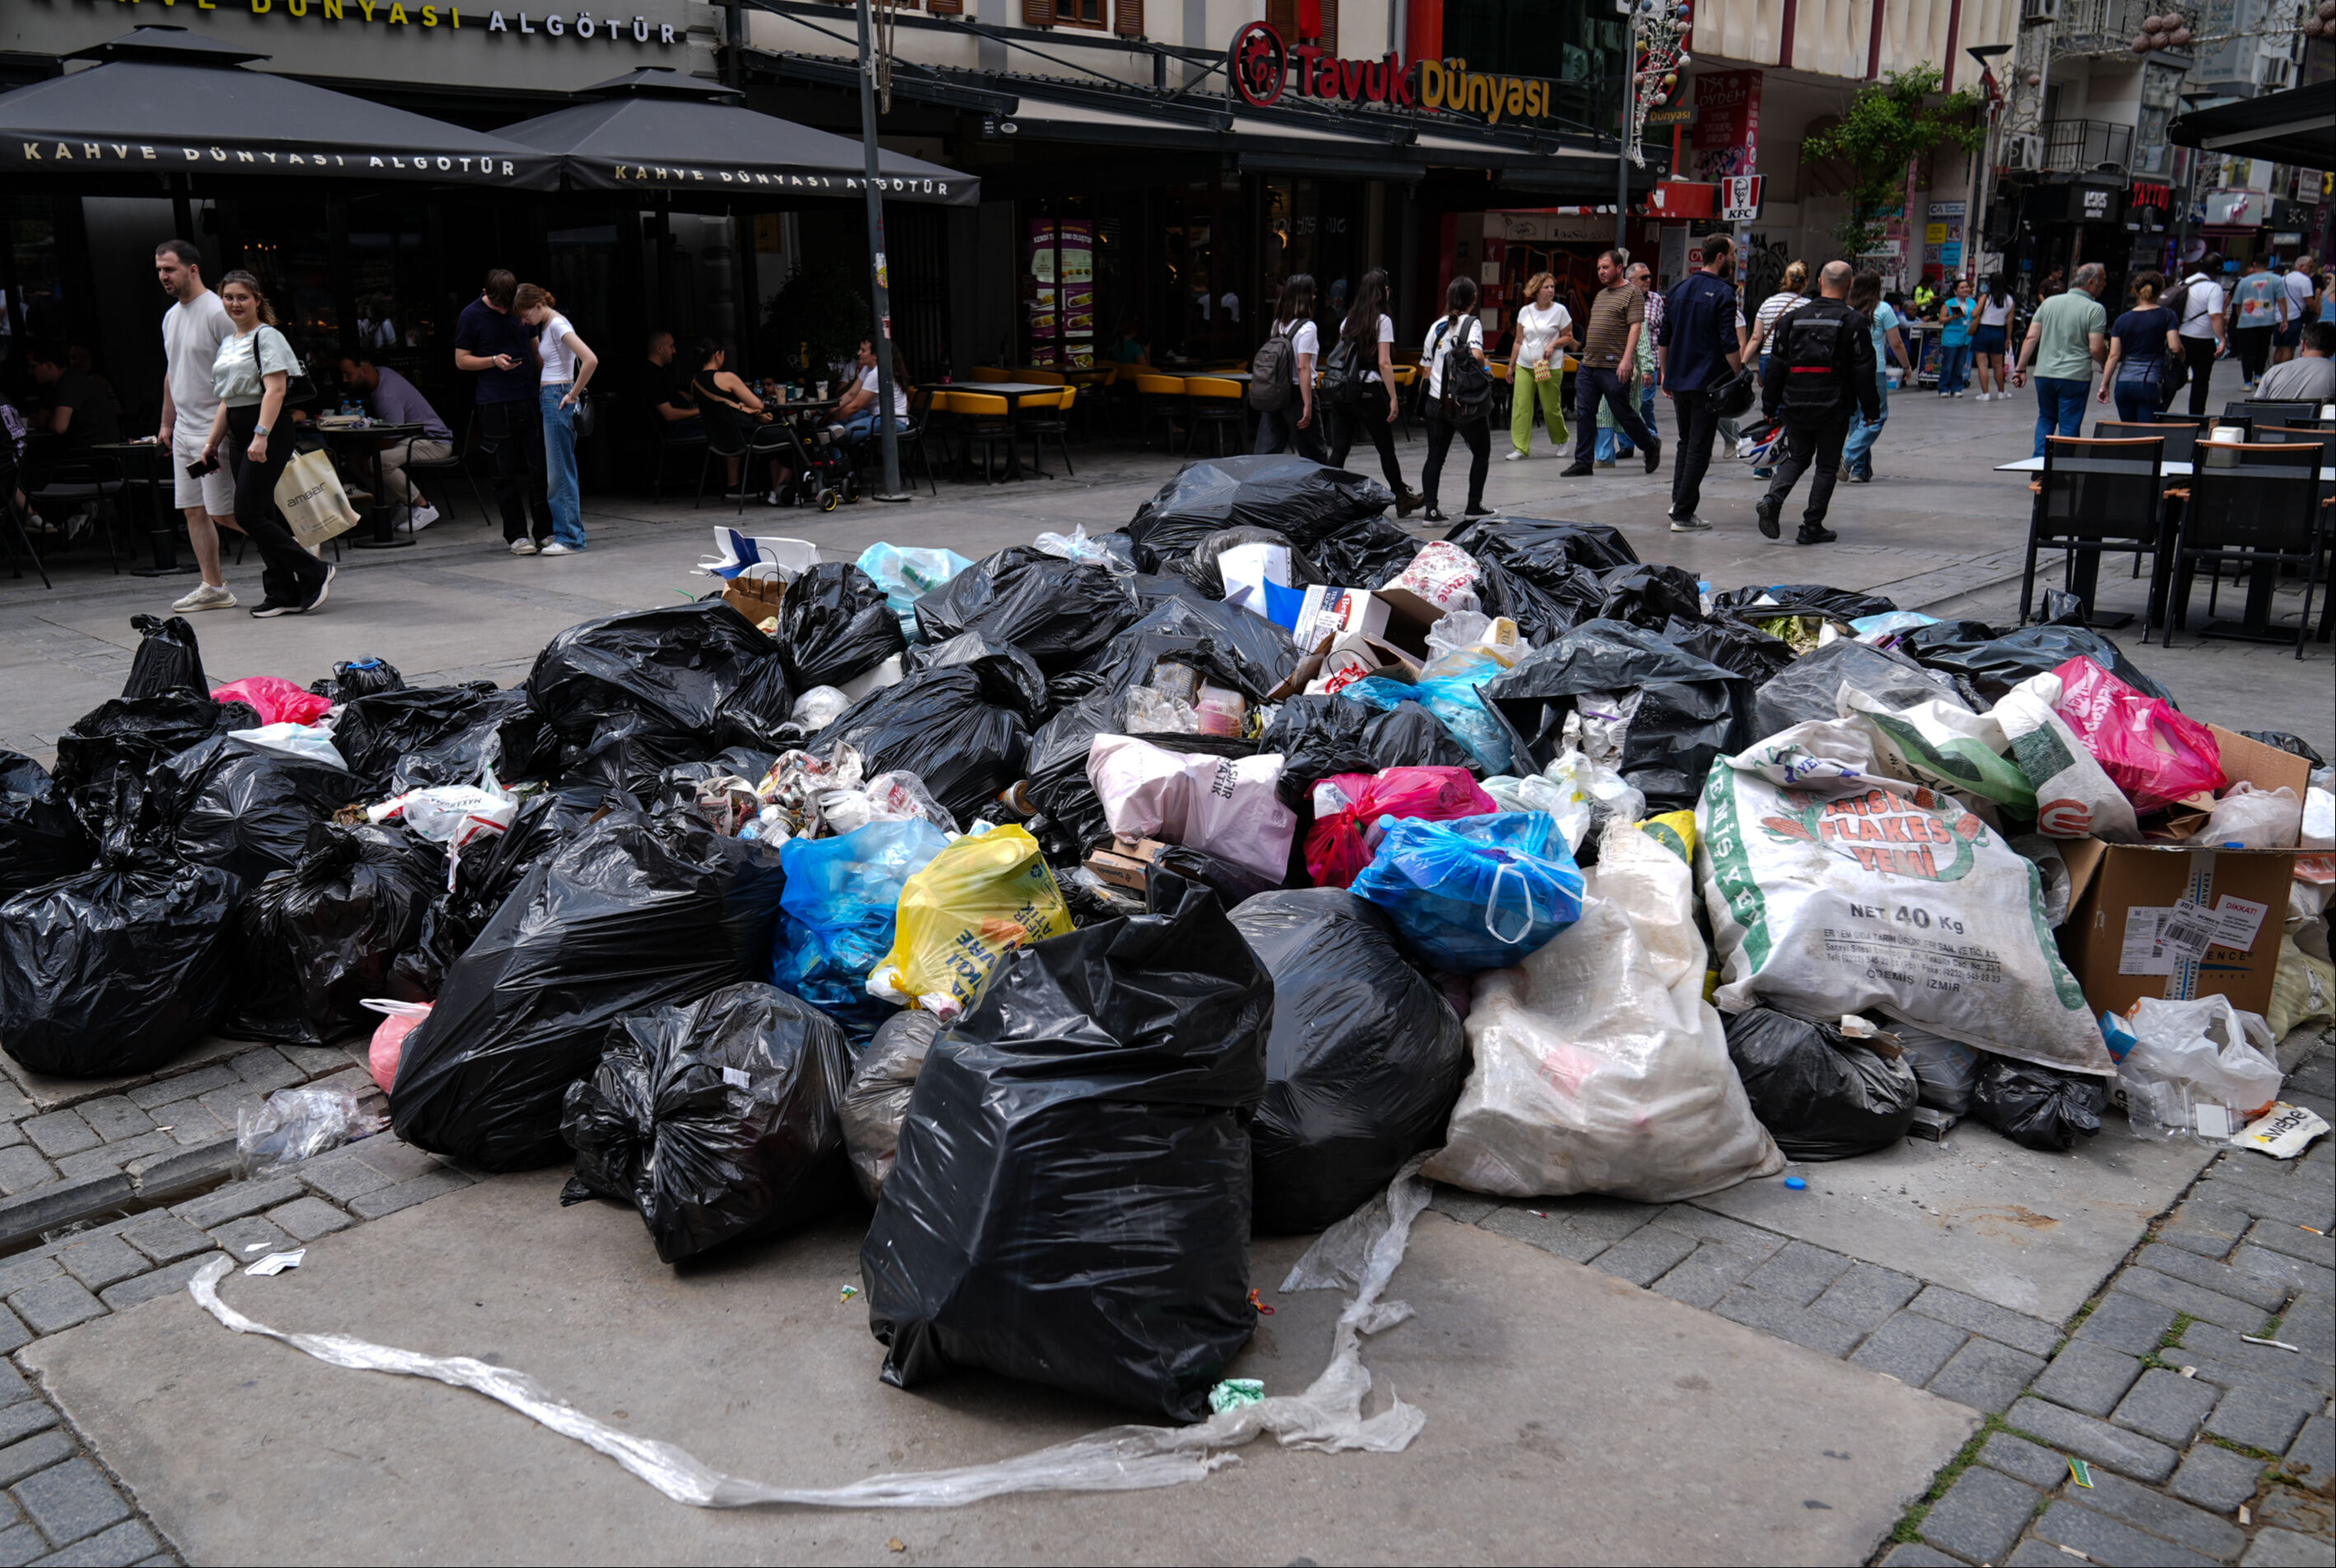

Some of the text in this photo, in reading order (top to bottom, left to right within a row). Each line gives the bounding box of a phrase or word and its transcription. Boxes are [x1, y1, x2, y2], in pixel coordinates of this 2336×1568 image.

[489, 11, 676, 44] ALGÖTÜR
[1290, 43, 1550, 124] Tavuk Dünyası
[1650, 110, 1692, 123] Dünyası
[23, 143, 157, 161] KAHVE
[183, 147, 344, 166] DÜNYASI
[616, 166, 705, 181] KAHVE
[720, 171, 830, 188] DÜNYASI
[1729, 208, 1753, 218] KFC
[1818, 814, 1952, 845] FLAKES
[1850, 844, 1939, 879] YEMİ
[1020, 901, 1053, 936] ATIK
[1850, 903, 1964, 934] NET 40 Kg
[2226, 901, 2258, 915] DİKKAT!
[955, 929, 998, 970] VRE
